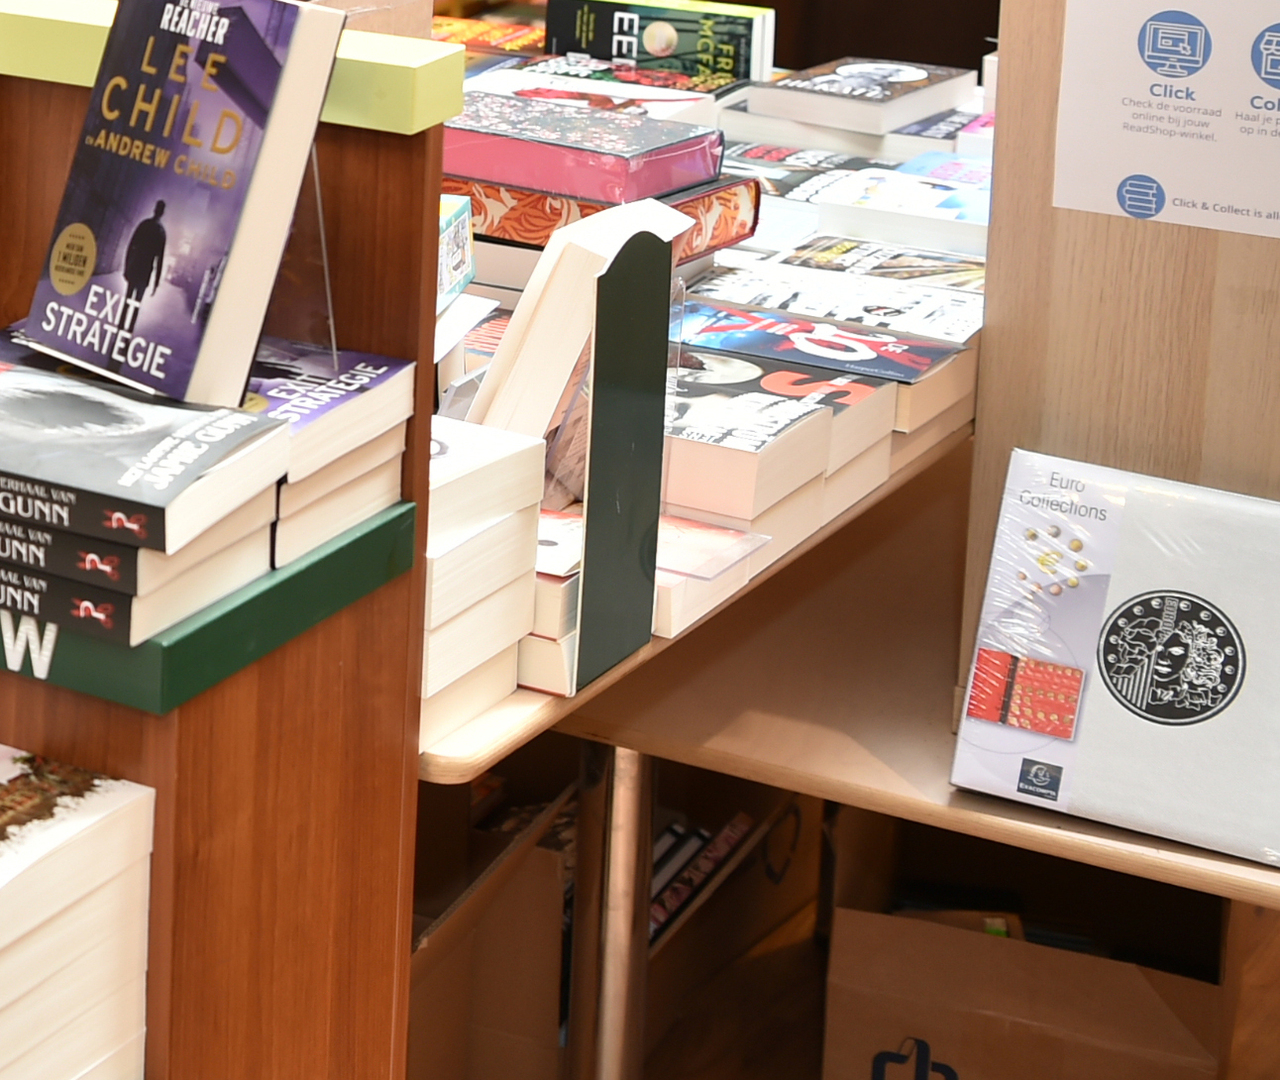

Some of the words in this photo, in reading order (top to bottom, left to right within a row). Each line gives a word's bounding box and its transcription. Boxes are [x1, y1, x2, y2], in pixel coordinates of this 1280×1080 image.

[160, 4, 229, 46] REACHER
[140, 35, 227, 91] LEE
[1122, 97, 1153, 109] Check
[1157, 102, 1170, 111] de
[1172, 104, 1222, 117] voorraad
[1150, 84, 1196, 101] Click
[99, 76, 242, 155] CHILD
[1132, 111, 1164, 122] online
[1168, 115, 1180, 126] bij
[1183, 118, 1210, 130] jouw
[1123, 122, 1217, 142] ReadShop-winkel.
[94, 128, 169, 169] ANDREW
[173, 151, 237, 189] CHILD
[1172, 197, 1198, 209] Click
[1201, 201, 1209, 210] &
[1212, 202, 1251, 216] Collect
[1254, 208, 1262, 218] is
[84, 284, 139, 326] EXIT
[42, 301, 172, 379] STRATEGIE
[1050, 471, 1085, 493] Euro
